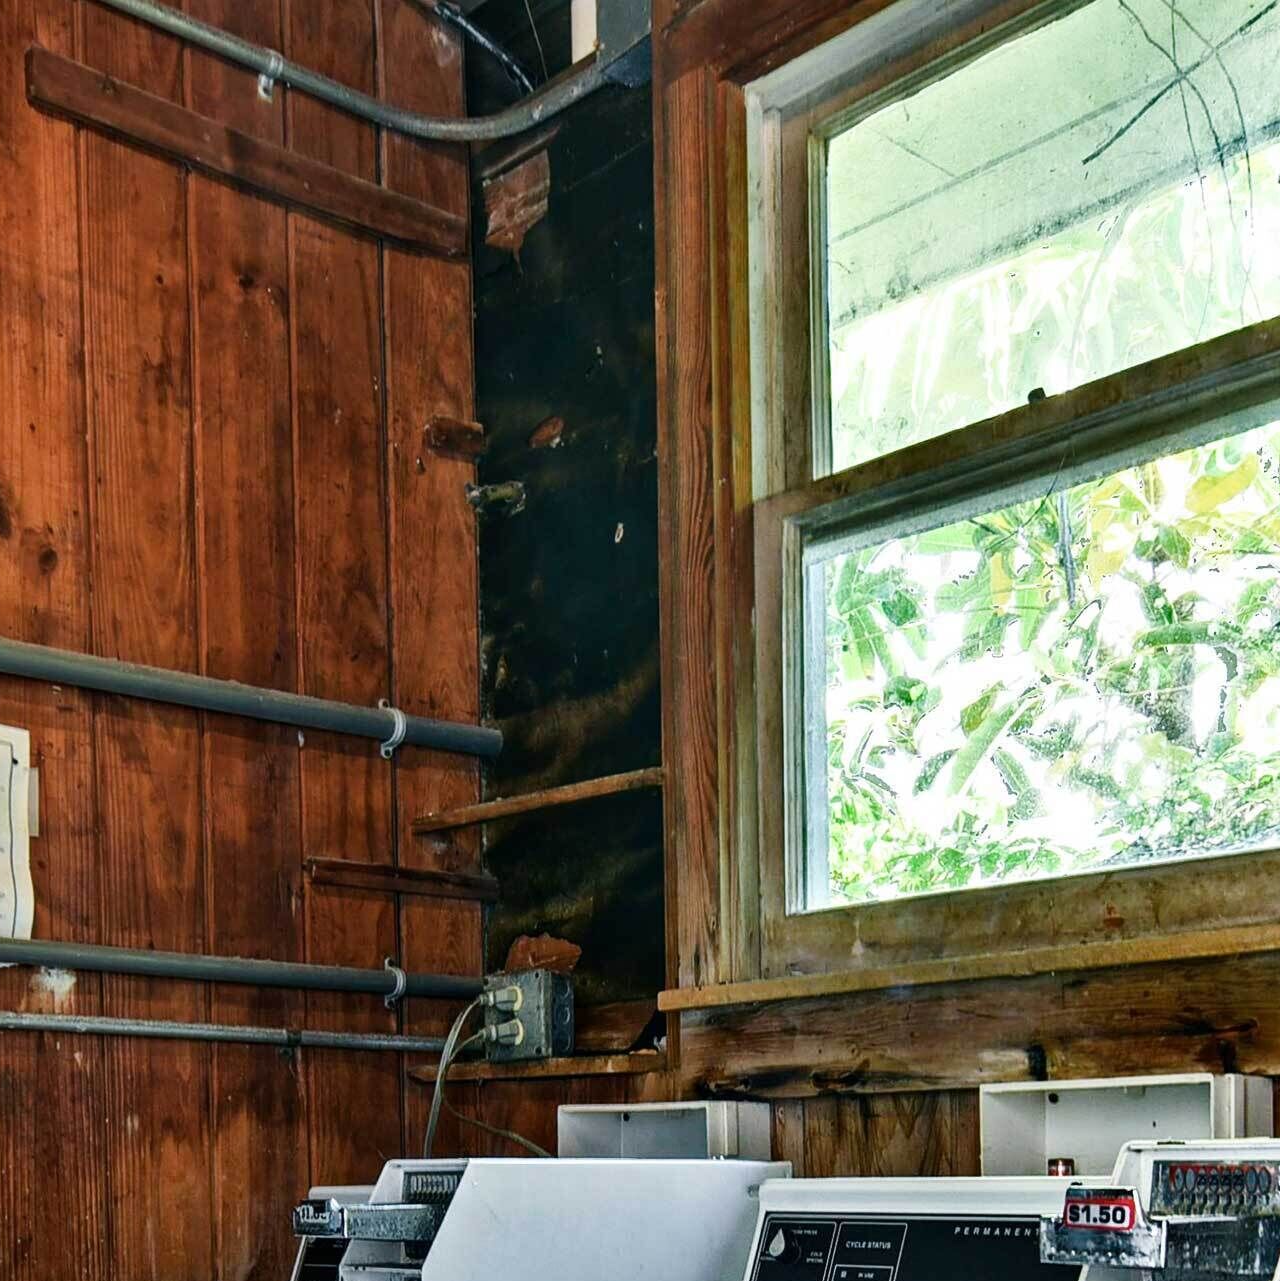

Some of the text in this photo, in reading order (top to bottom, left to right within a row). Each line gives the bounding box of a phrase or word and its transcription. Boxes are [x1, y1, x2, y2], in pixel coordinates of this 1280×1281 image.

[1069, 1205, 1126, 1224] $1.50
[846, 1240, 892, 1250] CYCLE STATUS
